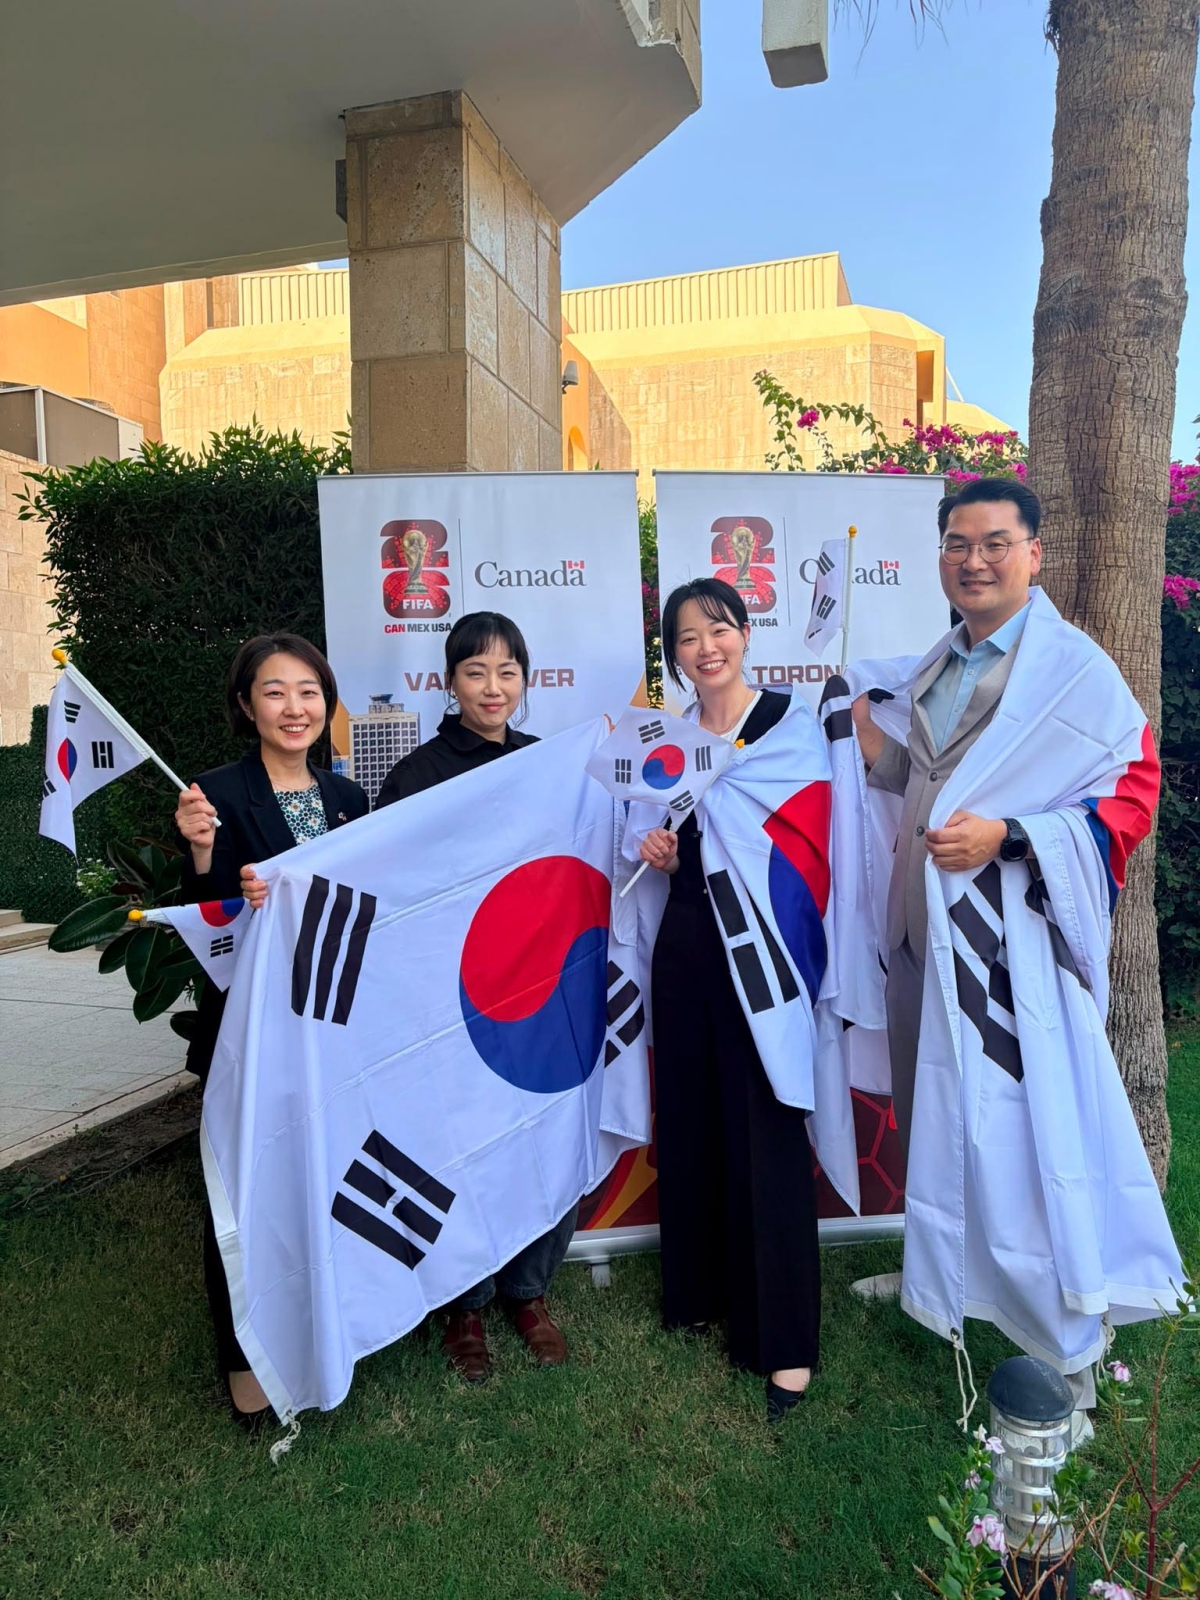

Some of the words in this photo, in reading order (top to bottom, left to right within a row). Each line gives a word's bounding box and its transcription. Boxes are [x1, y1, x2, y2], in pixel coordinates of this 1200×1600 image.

[475, 560, 587, 588] Canada
[799, 558, 901, 586] Cada
[402, 599, 433, 610] FIFA
[383, 624, 405, 633] CAN
[407, 623, 430, 632] MEX
[431, 623, 451, 632] USA
[759, 618, 778, 627] USA
[404, 669, 575, 691] VAVER
[751, 664, 840, 683] TORON
